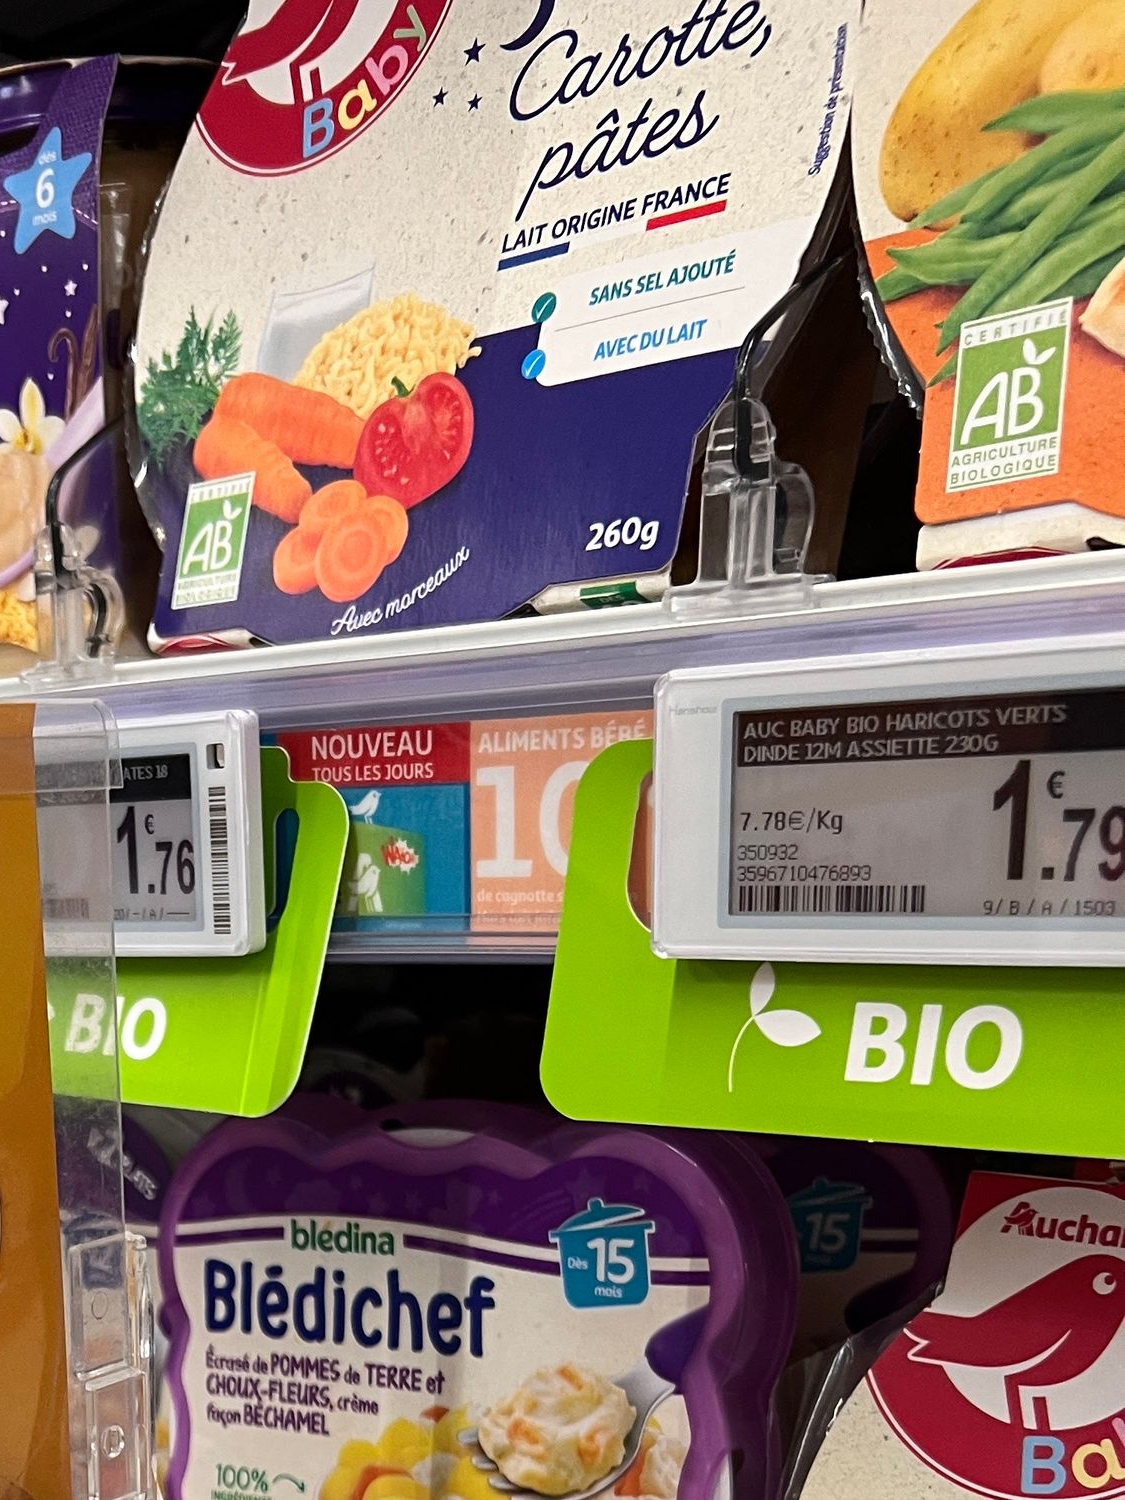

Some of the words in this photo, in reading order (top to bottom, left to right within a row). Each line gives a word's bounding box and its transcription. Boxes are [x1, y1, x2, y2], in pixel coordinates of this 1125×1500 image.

[300, 4, 429, 160] Baby
[516, 89, 720, 221] pâtes
[35, 168, 55, 209] 6
[31, 208, 58, 226] mois
[500, 222, 547, 255] LAIT
[551, 199, 638, 245] ORIGINE
[642, 174, 730, 216] FRANCE
[588, 278, 632, 306] SANS
[636, 270, 667, 295] SEL
[670, 250, 737, 290] AJOUTÉ
[593, 333, 636, 362] AVEC
[639, 327, 663, 355] DU
[665, 318, 708, 349] LAIT
[964, 309, 1068, 347] CERTIFIÉ
[959, 368, 1044, 446] AB
[950, 453, 1058, 486] BIOLOGIQUE
[951, 436, 1058, 468] AGRICULTURE
[183, 520, 234, 574] AB
[585, 516, 660, 554] 260g
[330, 605, 384, 636] Avec
[385, 546, 471, 619] morceaux
[478, 728, 585, 754] ALIMENTS
[744, 721, 785, 740] AUC
[790, 718, 839, 737] BABY
[847, 715, 879, 734] BIO
[886, 709, 990, 732] HARICOTS
[996, 704, 1068, 725] VERTS
[312, 730, 432, 761] NOUVEAU
[744, 743, 800, 763] DINDE
[805, 741, 842, 761] 12M
[847, 737, 940, 758] ASSIETTE
[945, 733, 999, 753] 230G
[312, 766, 352, 784] TOUS
[355, 764, 382, 781] LES
[384, 762, 434, 781] JOURS
[740, 808, 843, 835] 7.78€/Kg
[737, 844, 798, 861] 350932
[736, 865, 871, 882] 3596710476893
[65, 994, 166, 1061] BIO
[844, 1002, 1023, 1090] BIO
[291, 1219, 394, 1256] blédina
[805, 1211, 849, 1252] 15
[588, 1237, 635, 1285] 15
[205, 1258, 495, 1357] Blédichef
[253, 1356, 268, 1374] de
[270, 1353, 340, 1382] POMMES
[344, 1364, 361, 1385] de
[364, 1363, 422, 1392] TERRE
[426, 1370, 445, 1395] et
[206, 1373, 333, 1412] CHOUX-FLEURS,
[337, 1394, 379, 1415] crème
[206, 1405, 241, 1429] façon
[244, 1402, 330, 1436] BÉCHAMEL
[216, 1463, 268, 1493] 100%
